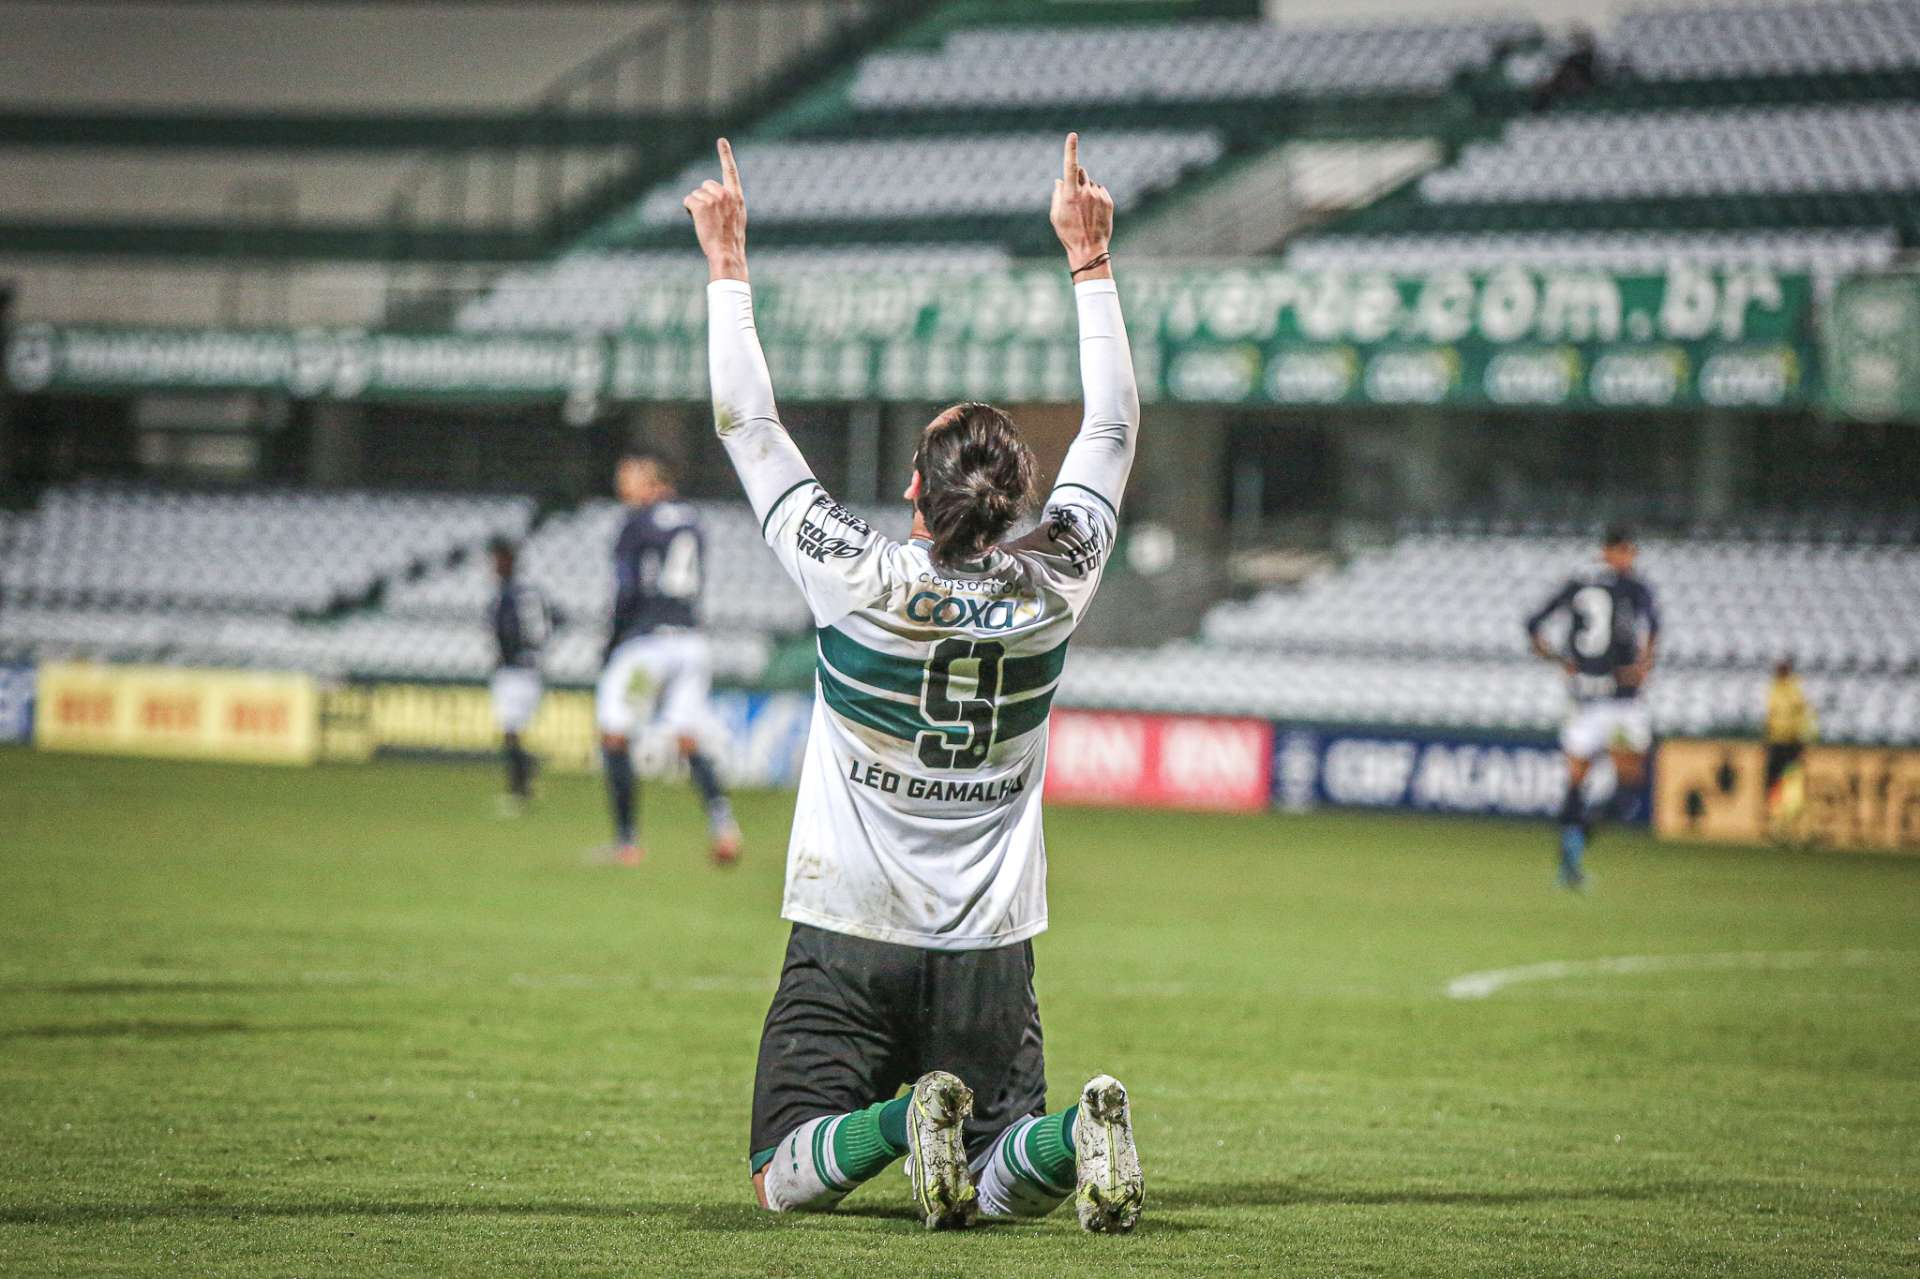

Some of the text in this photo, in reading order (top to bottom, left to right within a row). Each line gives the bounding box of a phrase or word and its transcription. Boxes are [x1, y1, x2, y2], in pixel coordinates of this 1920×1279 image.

[658, 528, 700, 599] 4
[1571, 585, 1613, 658] 3
[914, 638, 1004, 771] 9
[850, 760, 900, 794] LÉO
